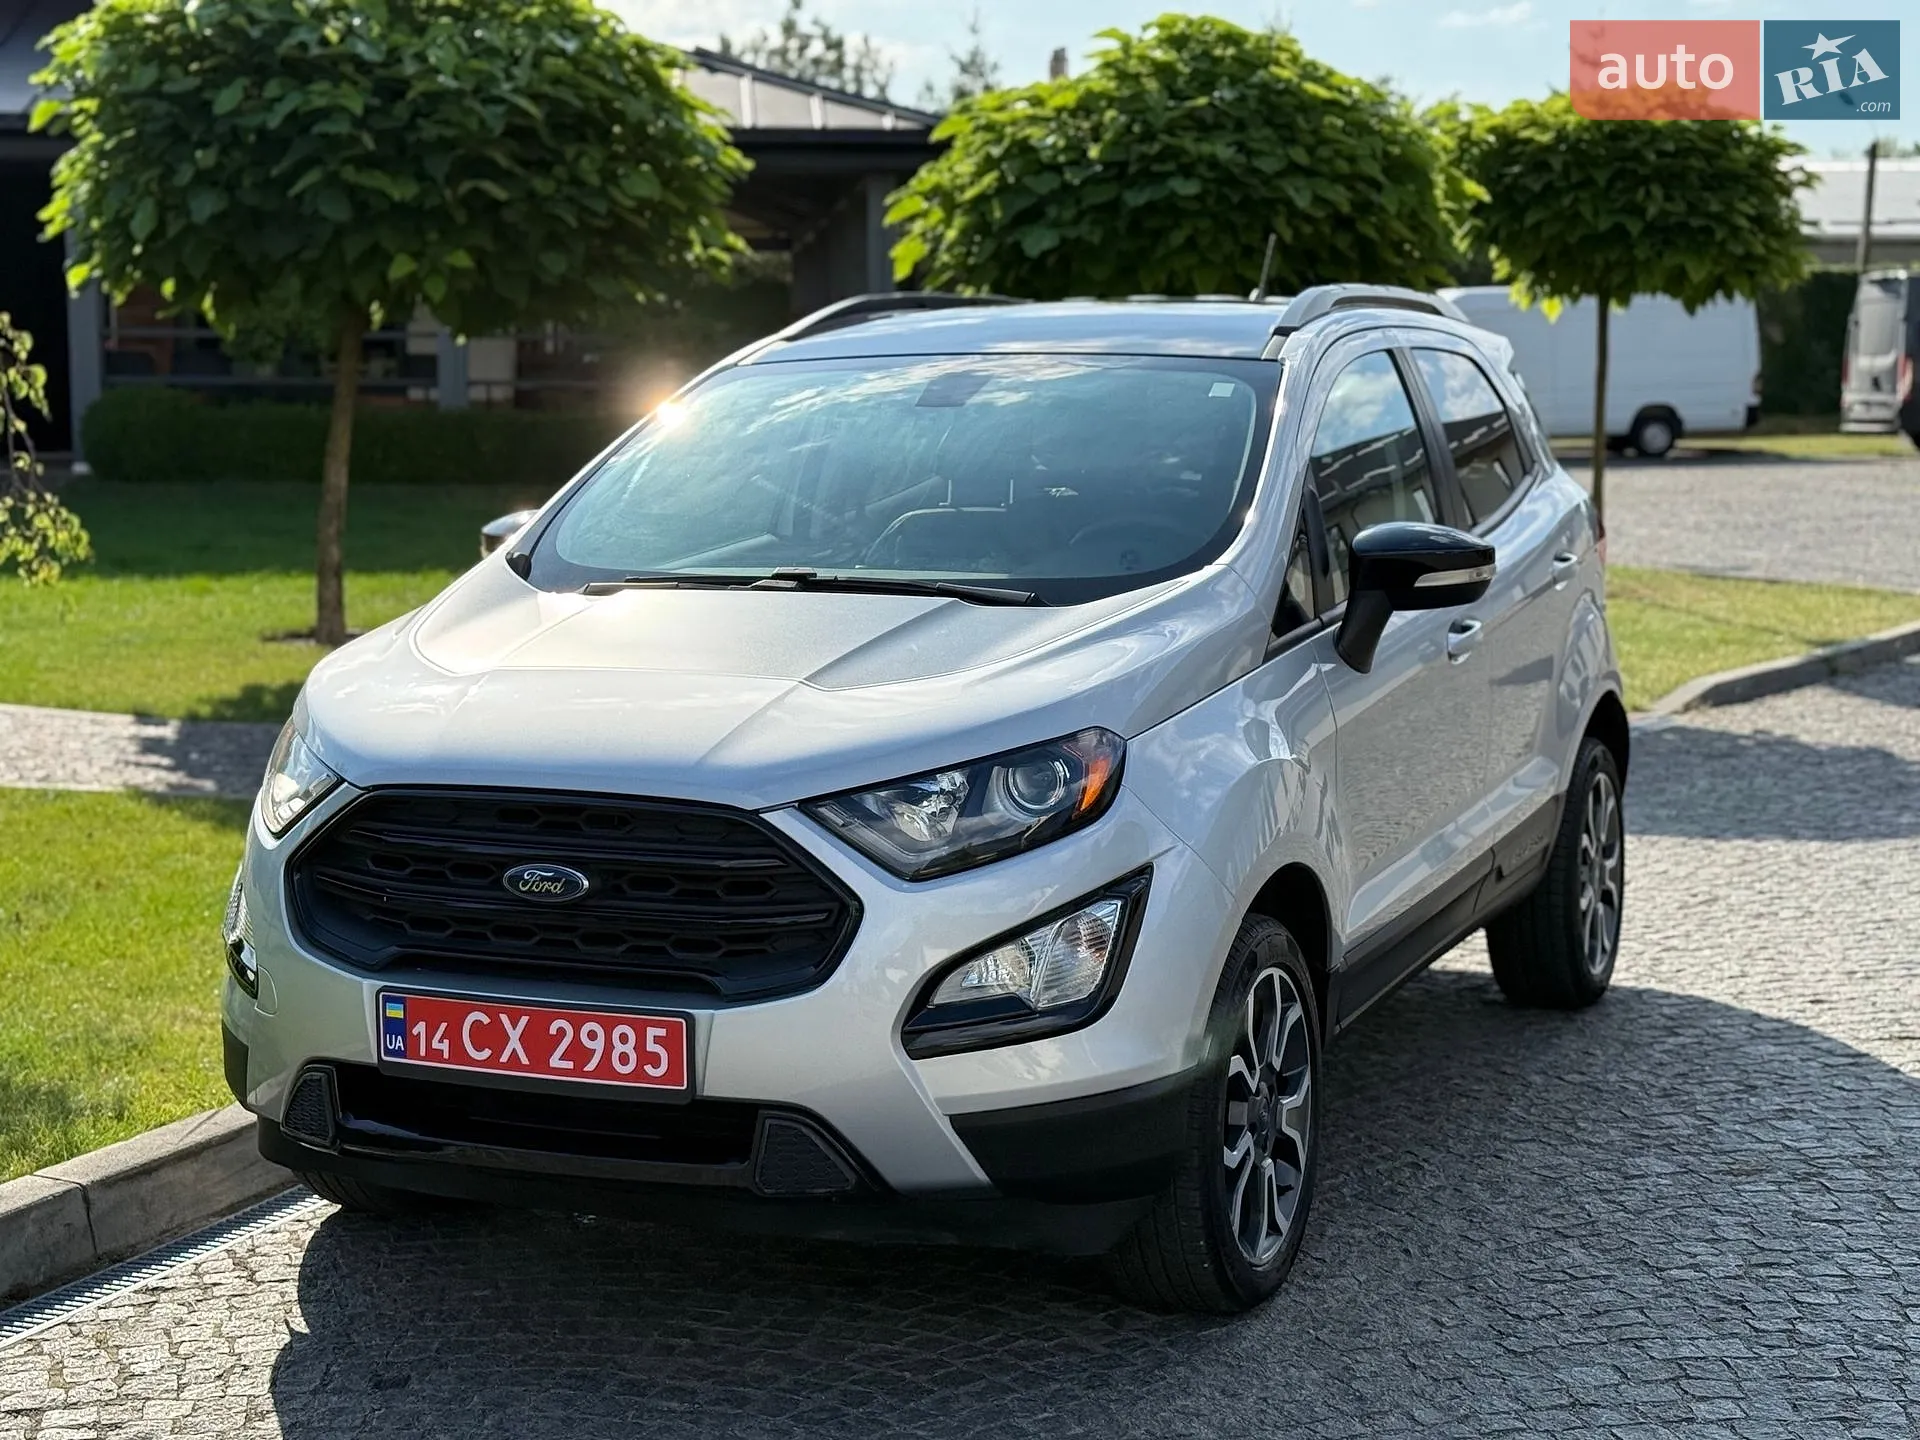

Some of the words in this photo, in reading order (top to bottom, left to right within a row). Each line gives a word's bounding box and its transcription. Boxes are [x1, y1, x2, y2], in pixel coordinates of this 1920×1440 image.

[519, 869, 566, 894] Ford
[386, 1034, 404, 1051] UA
[411, 1021, 450, 1059] 14
[462, 1011, 530, 1065] CX
[549, 1019, 669, 1077] 2985
